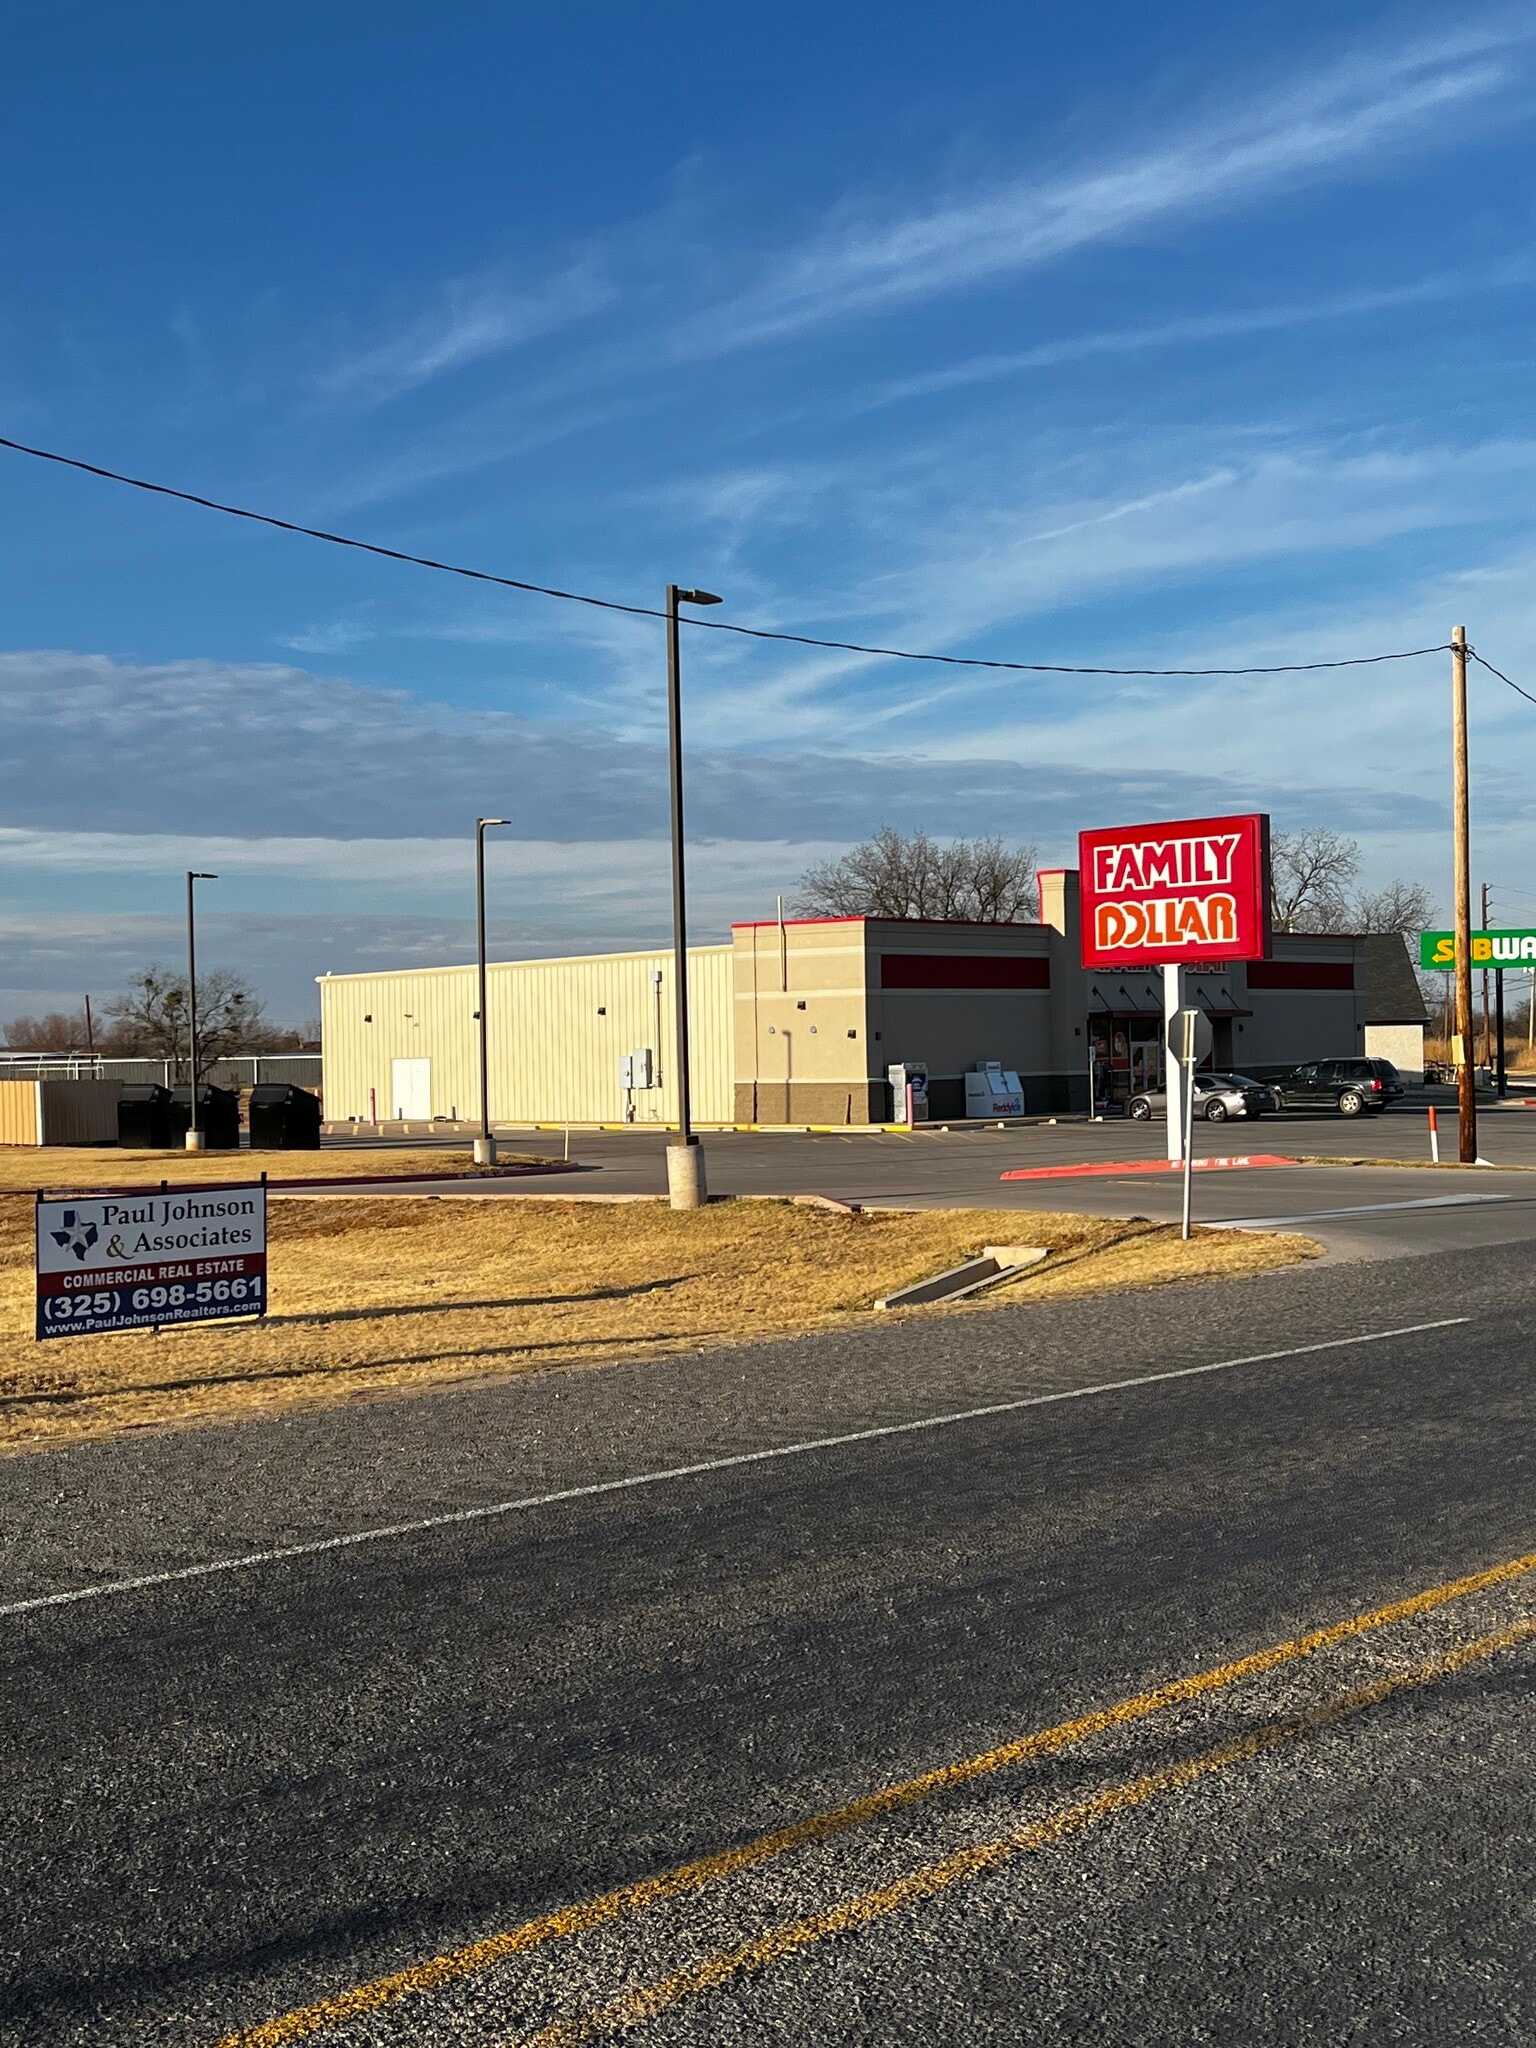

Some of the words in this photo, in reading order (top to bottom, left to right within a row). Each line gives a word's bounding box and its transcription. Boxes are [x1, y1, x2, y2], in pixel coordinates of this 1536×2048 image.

[1094, 833, 1242, 893] FAMILY
[1095, 892, 1237, 951] DOLLAR
[1432, 936, 1536, 963] SBWA
[101, 1201, 156, 1227] Paul
[161, 1198, 255, 1227] Johnson
[106, 1234, 136, 1260] &
[132, 1226, 252, 1253] Associates
[63, 1266, 155, 1289] COMMERCIAL
[159, 1263, 193, 1279] REAL
[196, 1259, 245, 1275] ESTATE
[44, 1292, 121, 1320] (325)
[132, 1275, 262, 1310] 698-5661
[44, 1301, 262, 1335] www.PaulJohnsonRealtors.com
